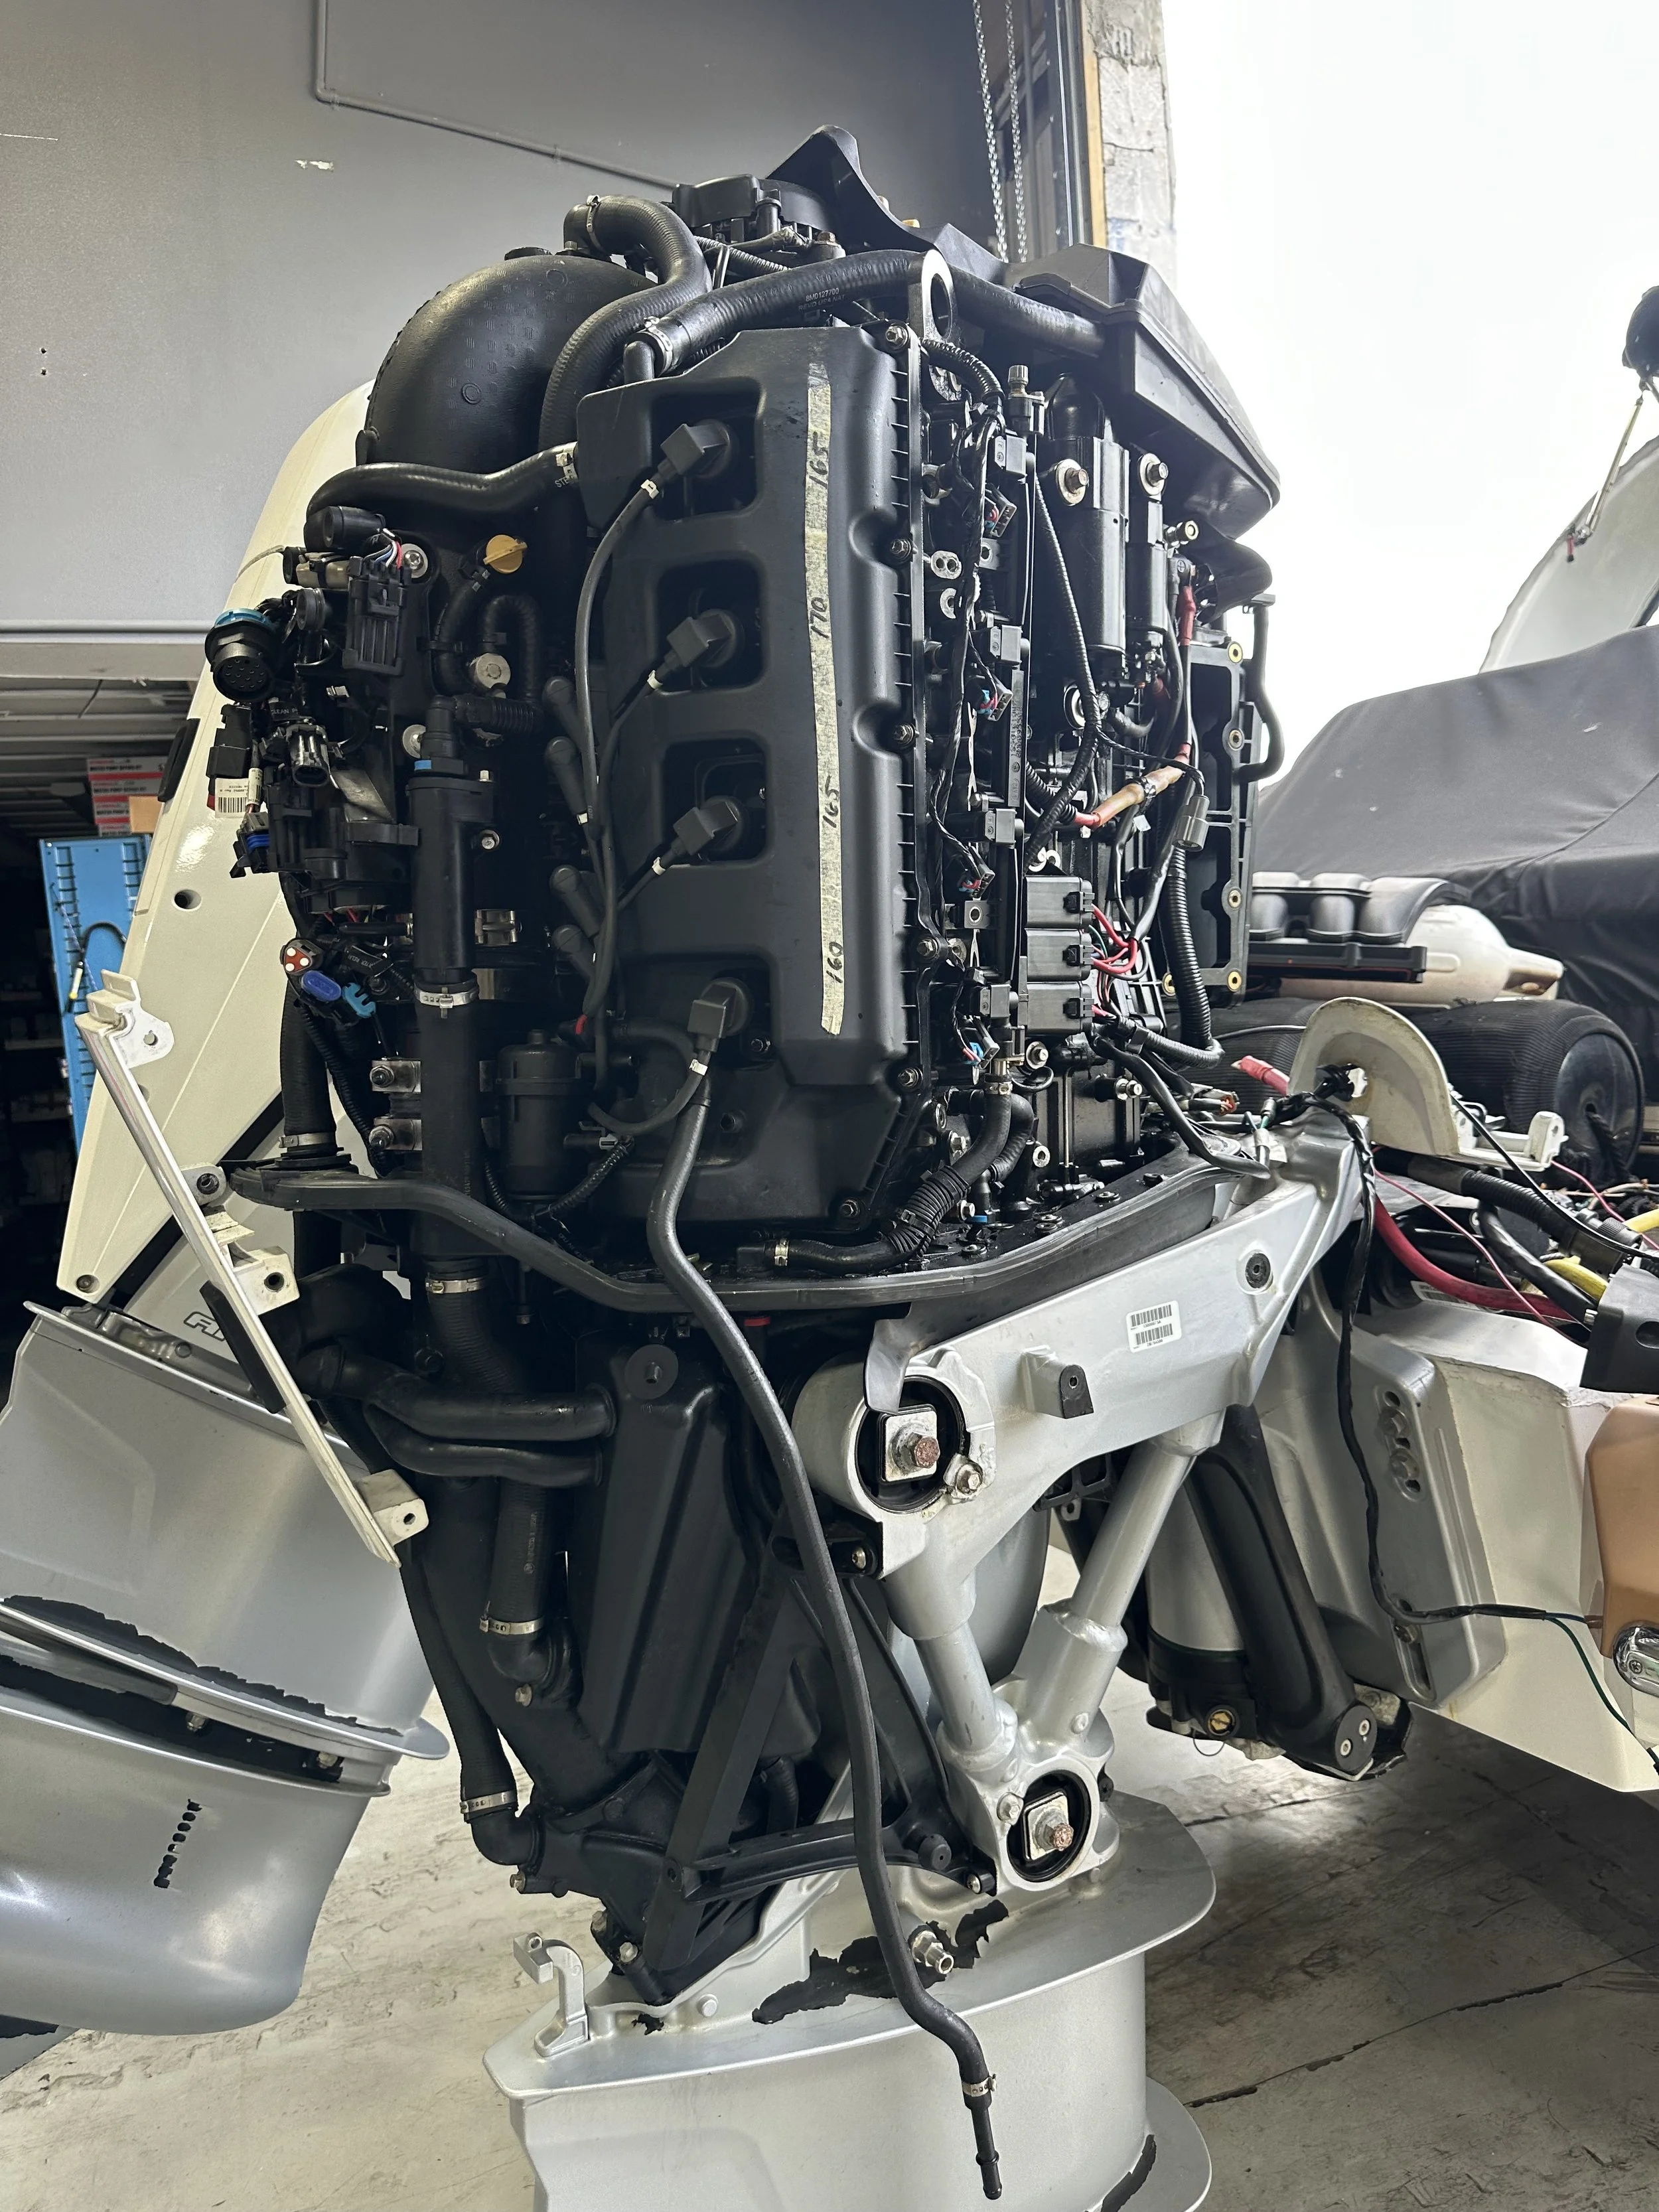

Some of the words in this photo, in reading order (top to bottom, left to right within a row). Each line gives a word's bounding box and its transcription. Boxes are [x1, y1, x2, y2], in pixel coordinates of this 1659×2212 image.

[806, 287, 839, 302] 8M0127700
[809, 431, 829, 490] 165
[810, 597, 830, 639] 170
[822, 774, 839, 828] 165
[826, 941, 844, 984] 160
